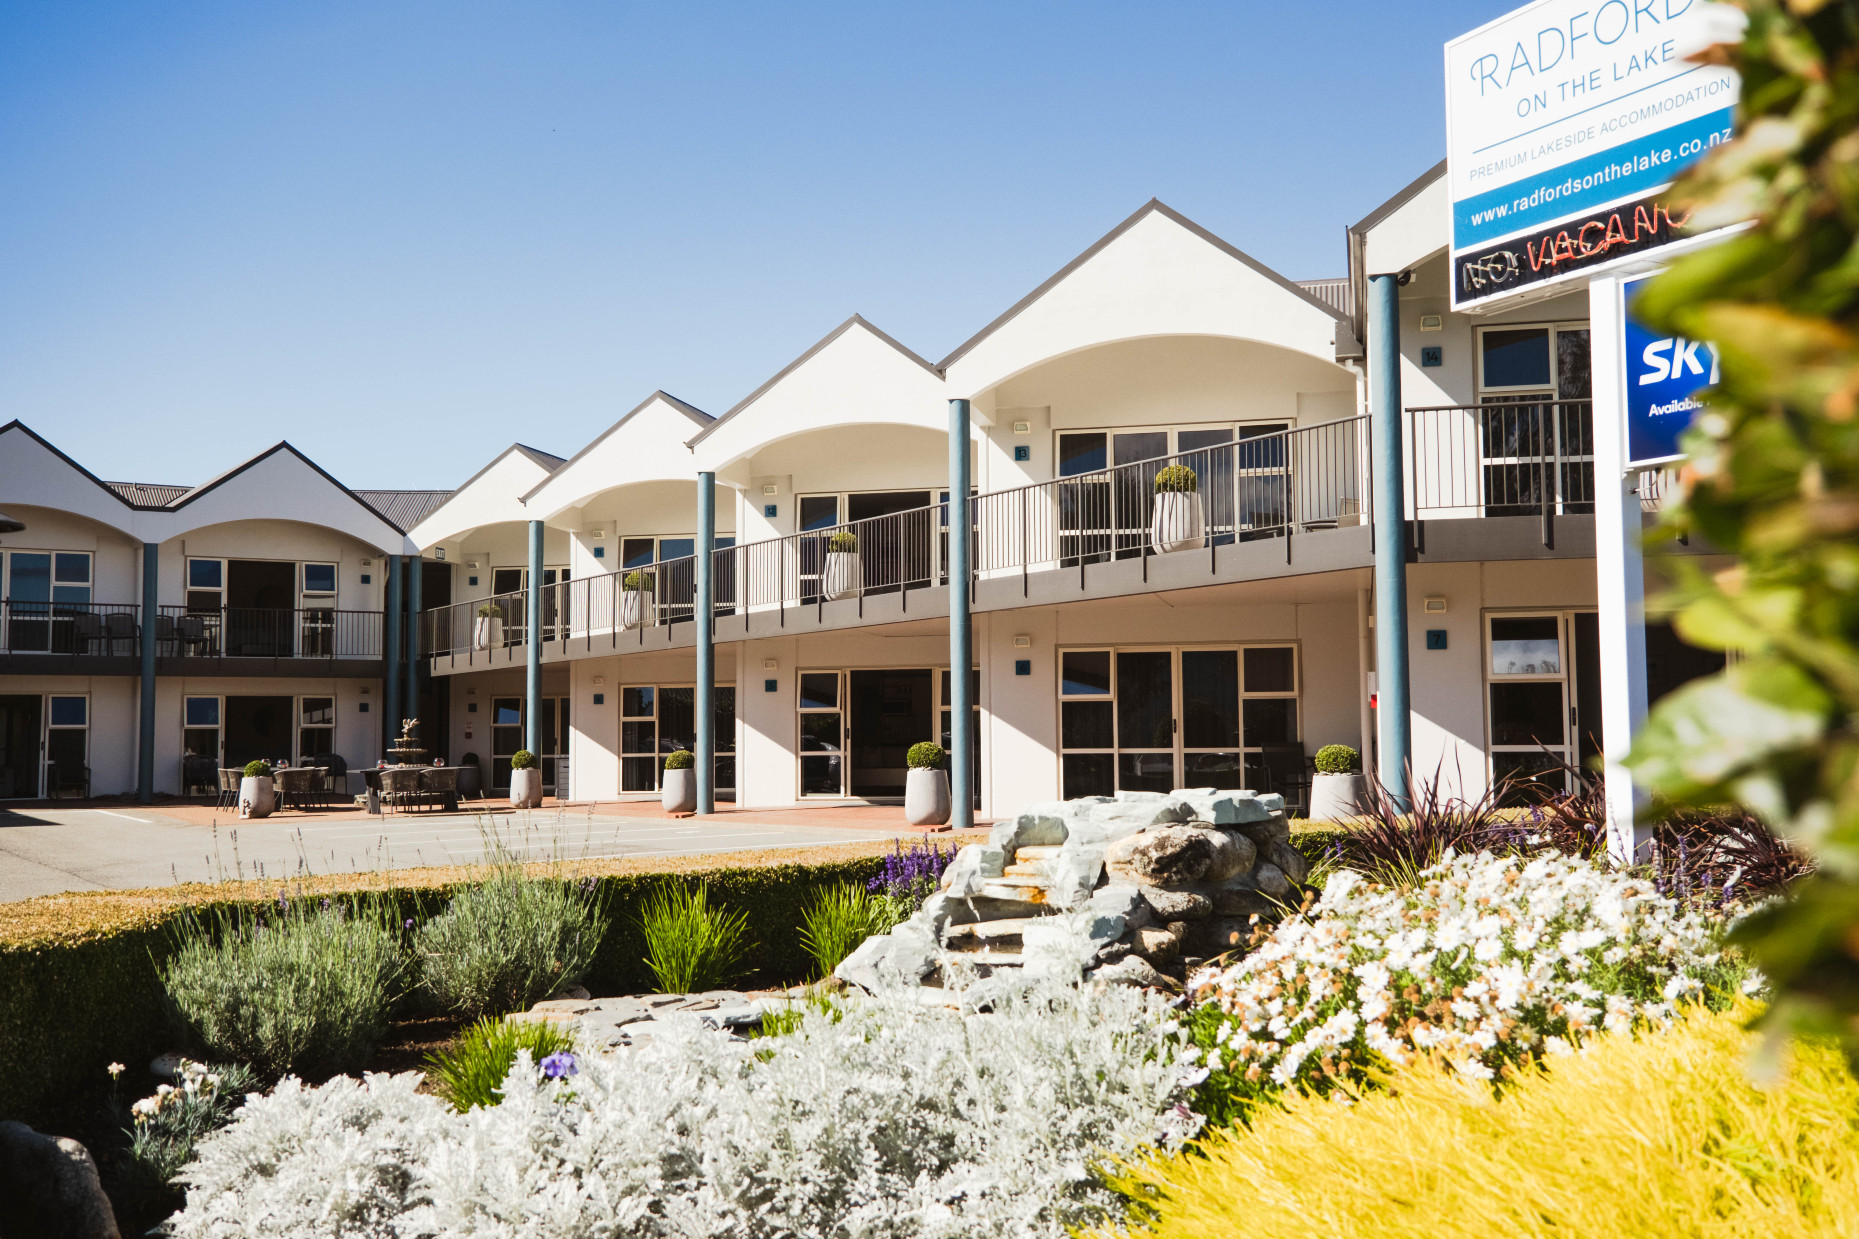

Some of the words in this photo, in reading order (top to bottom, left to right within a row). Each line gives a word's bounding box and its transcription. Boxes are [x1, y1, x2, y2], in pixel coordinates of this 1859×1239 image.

[1516, 90, 1547, 118] ON
[1557, 68, 1602, 102] THE
[1613, 39, 1676, 82] LAKE
[1470, 151, 1527, 182] PREMIUM
[1531, 126, 1596, 160] LAKESIDE
[1600, 76, 1731, 135] ACCOMMODATION
[1470, 127, 1733, 227] www.radfordsonthelake.co.nz
[1526, 202, 1694, 272] VACANC
[1425, 351, 1439, 363] 14
[1638, 336, 1720, 386] SKY
[1017, 448, 1027, 458] 13
[767, 507, 775, 516] 12
[1432, 633, 1441, 646] 7
